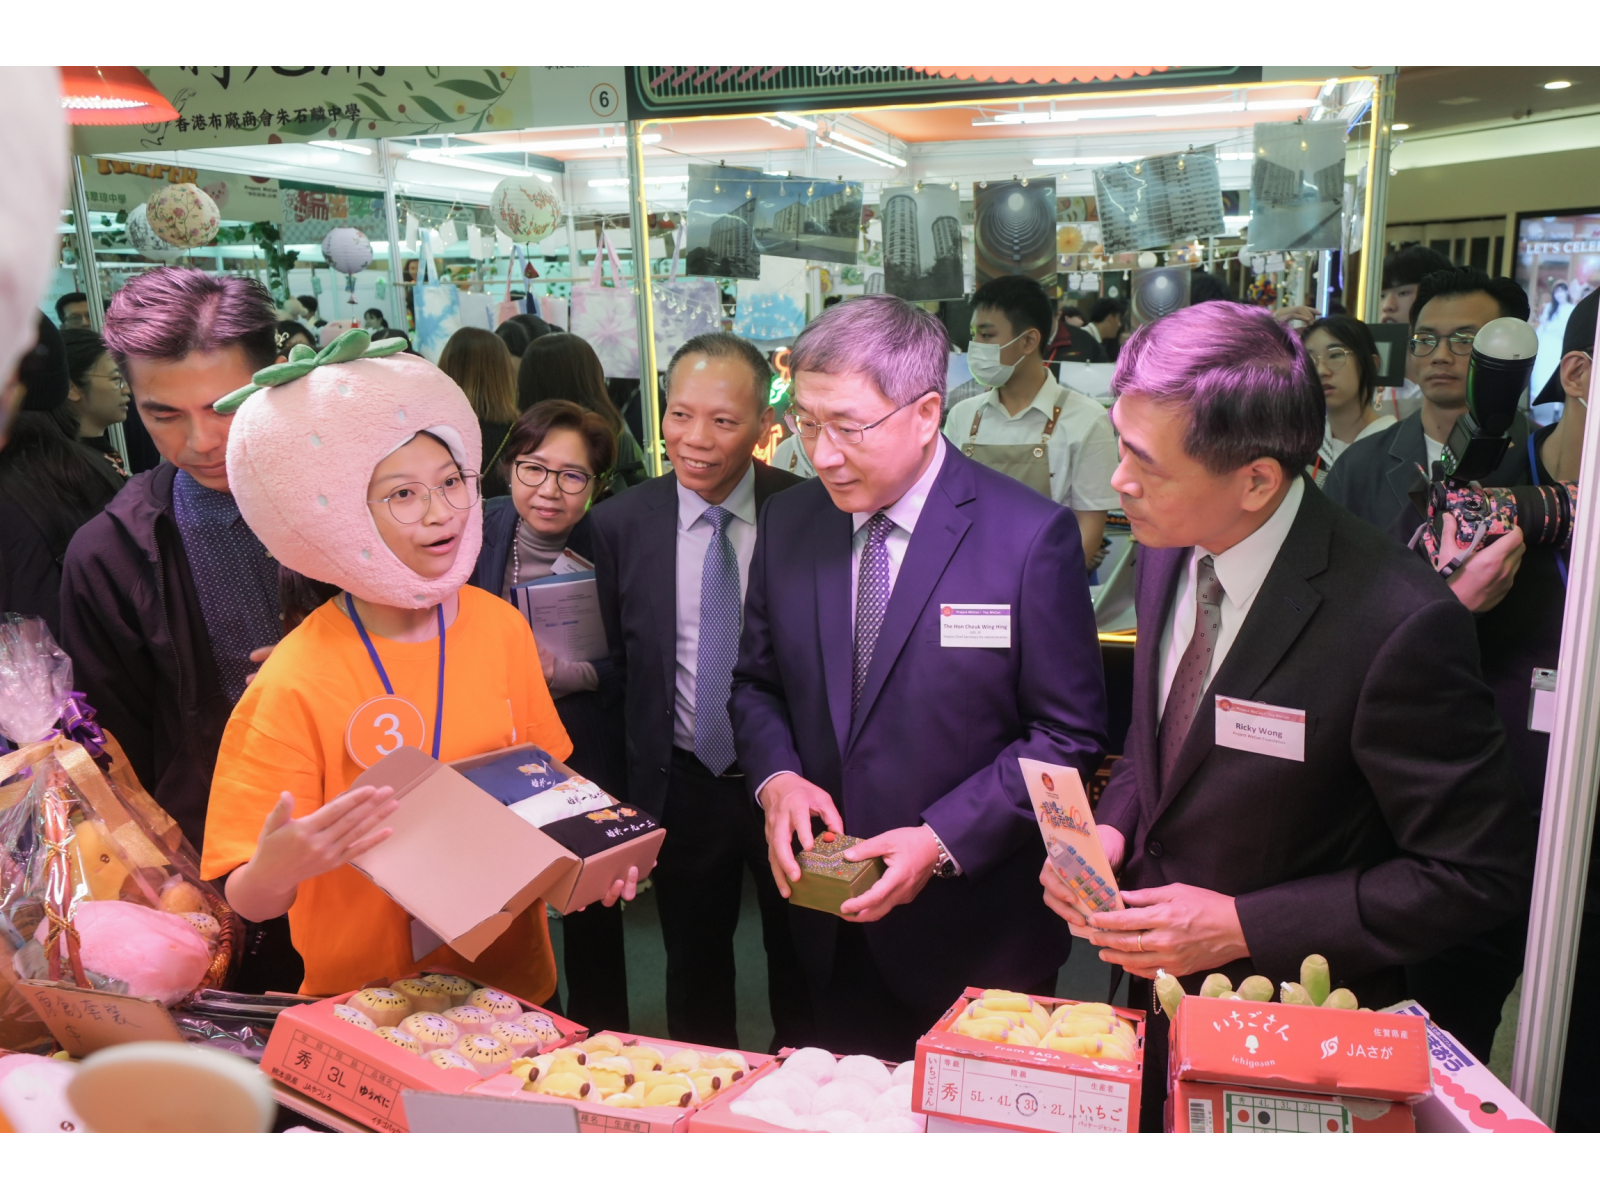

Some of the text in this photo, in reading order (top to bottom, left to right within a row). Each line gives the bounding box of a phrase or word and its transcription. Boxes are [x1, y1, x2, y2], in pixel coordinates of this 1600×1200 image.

[599, 90, 609, 108] 6
[1526, 242, 1560, 254] LET'S
[373, 713, 404, 756] 3
[1236, 722, 1282, 738] Ricky Wong
[1213, 1010, 1290, 1042] いちごさん
[1373, 1027, 1409, 1040] 佐賀県産
[294, 1049, 313, 1070] 秀
[994, 1046, 1061, 1060] From SAGA
[1346, 1043, 1394, 1061] JAさが
[1427, 1033, 1464, 1072] まおう
[944, 1058, 960, 1069] 等級
[1231, 1054, 1276, 1069] ichigosan
[327, 1066, 346, 1089] 3L
[924, 1056, 938, 1107] いちごさん
[1010, 1068, 1027, 1079] 階級
[941, 1082, 959, 1102] 秀
[1090, 1082, 1114, 1093] 生産者
[359, 1085, 391, 1109] ゆうべに
[970, 1090, 984, 1102] 5L
[997, 1095, 1011, 1107] 4L
[1050, 1103, 1065, 1116] 2L
[1258, 1099, 1270, 1107] 4L
[1280, 1101, 1292, 1110] 3L
[1079, 1103, 1122, 1122] いちご
[1303, 1103, 1314, 1111] 2L
